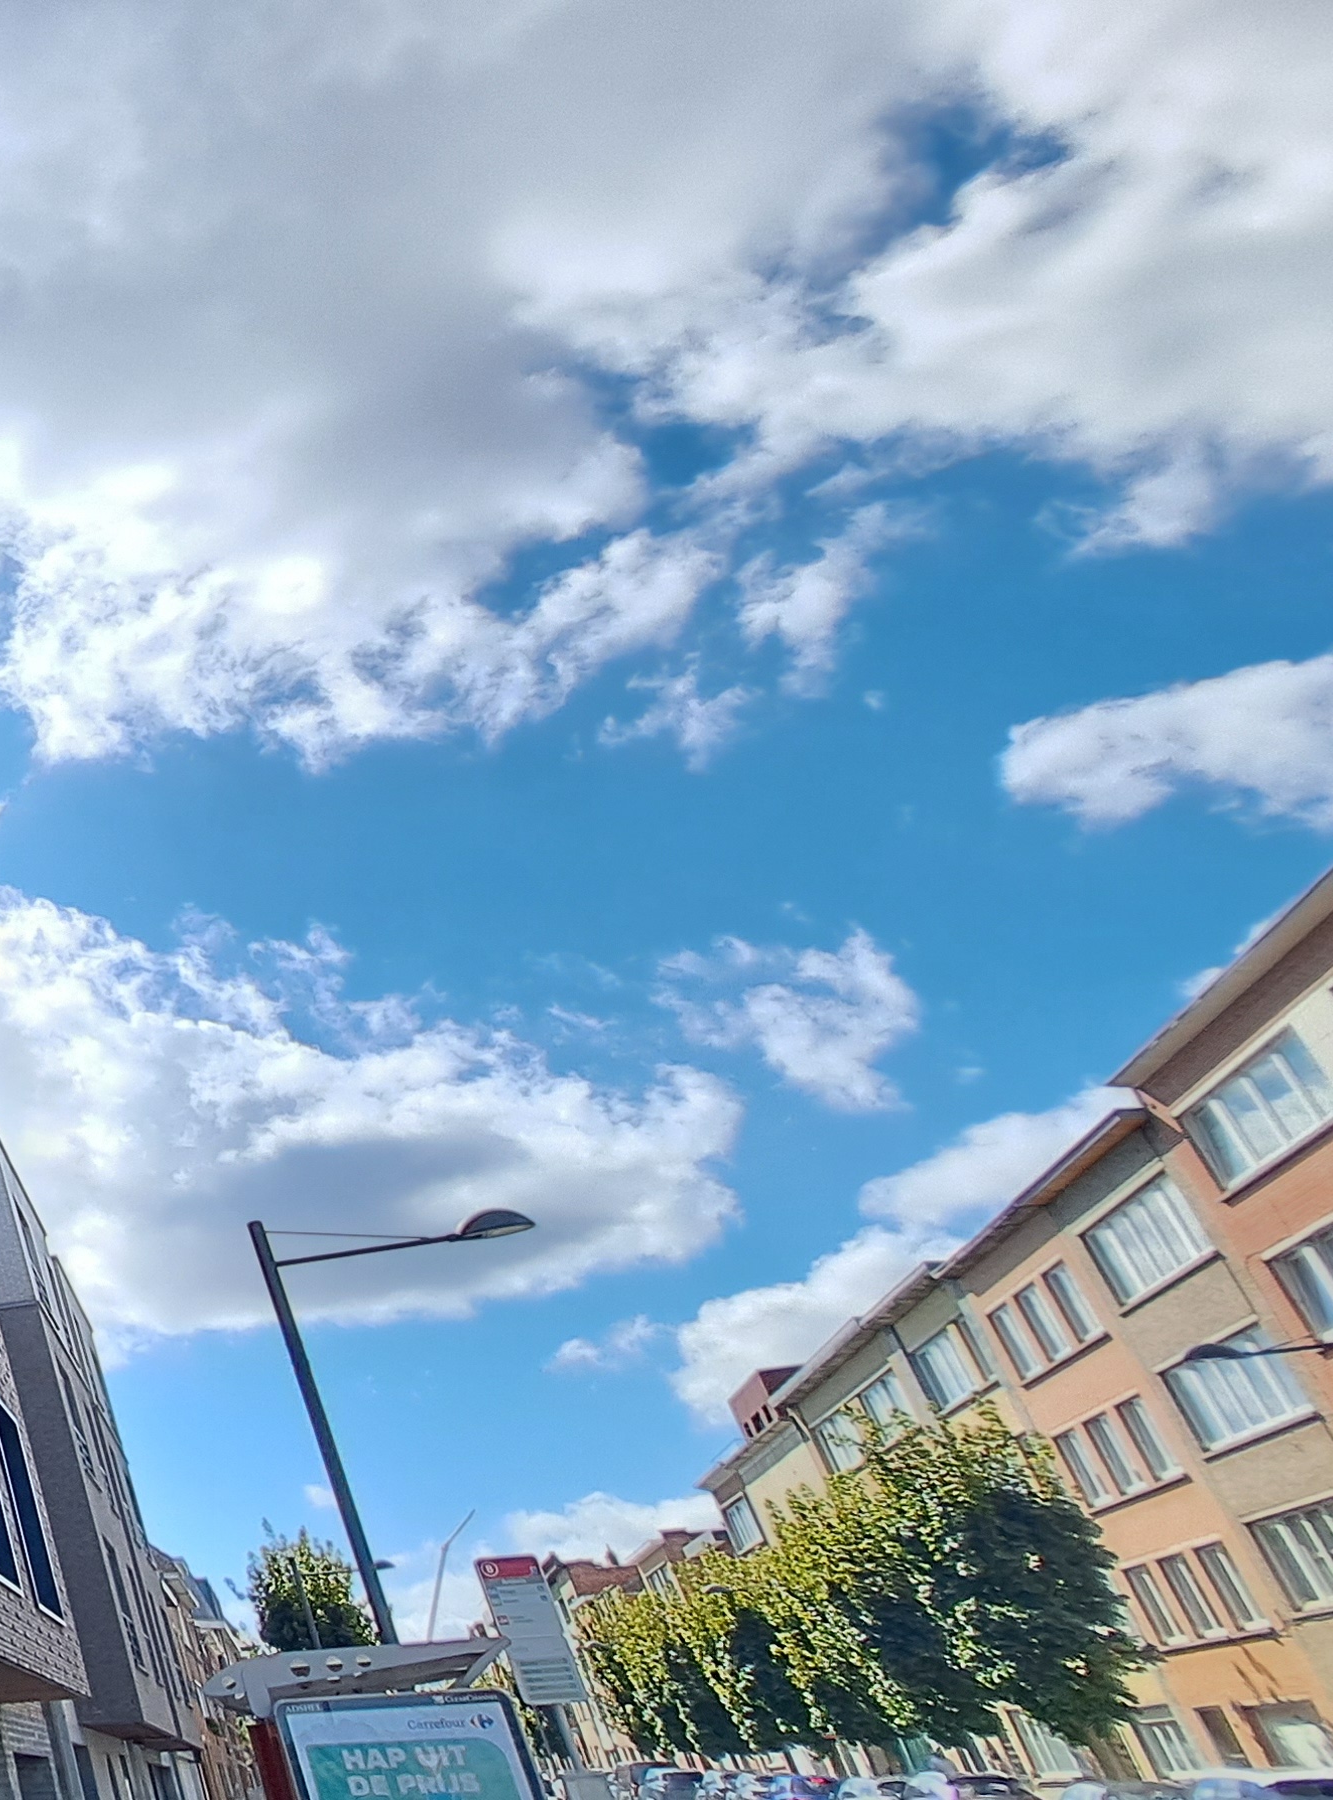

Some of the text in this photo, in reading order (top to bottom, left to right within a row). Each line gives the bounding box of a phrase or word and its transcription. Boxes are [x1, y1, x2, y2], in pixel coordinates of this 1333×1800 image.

[407, 1717, 466, 1730] Carrefour
[341, 1744, 467, 1771] HAP UIT
[346, 1773, 391, 1797] DE
